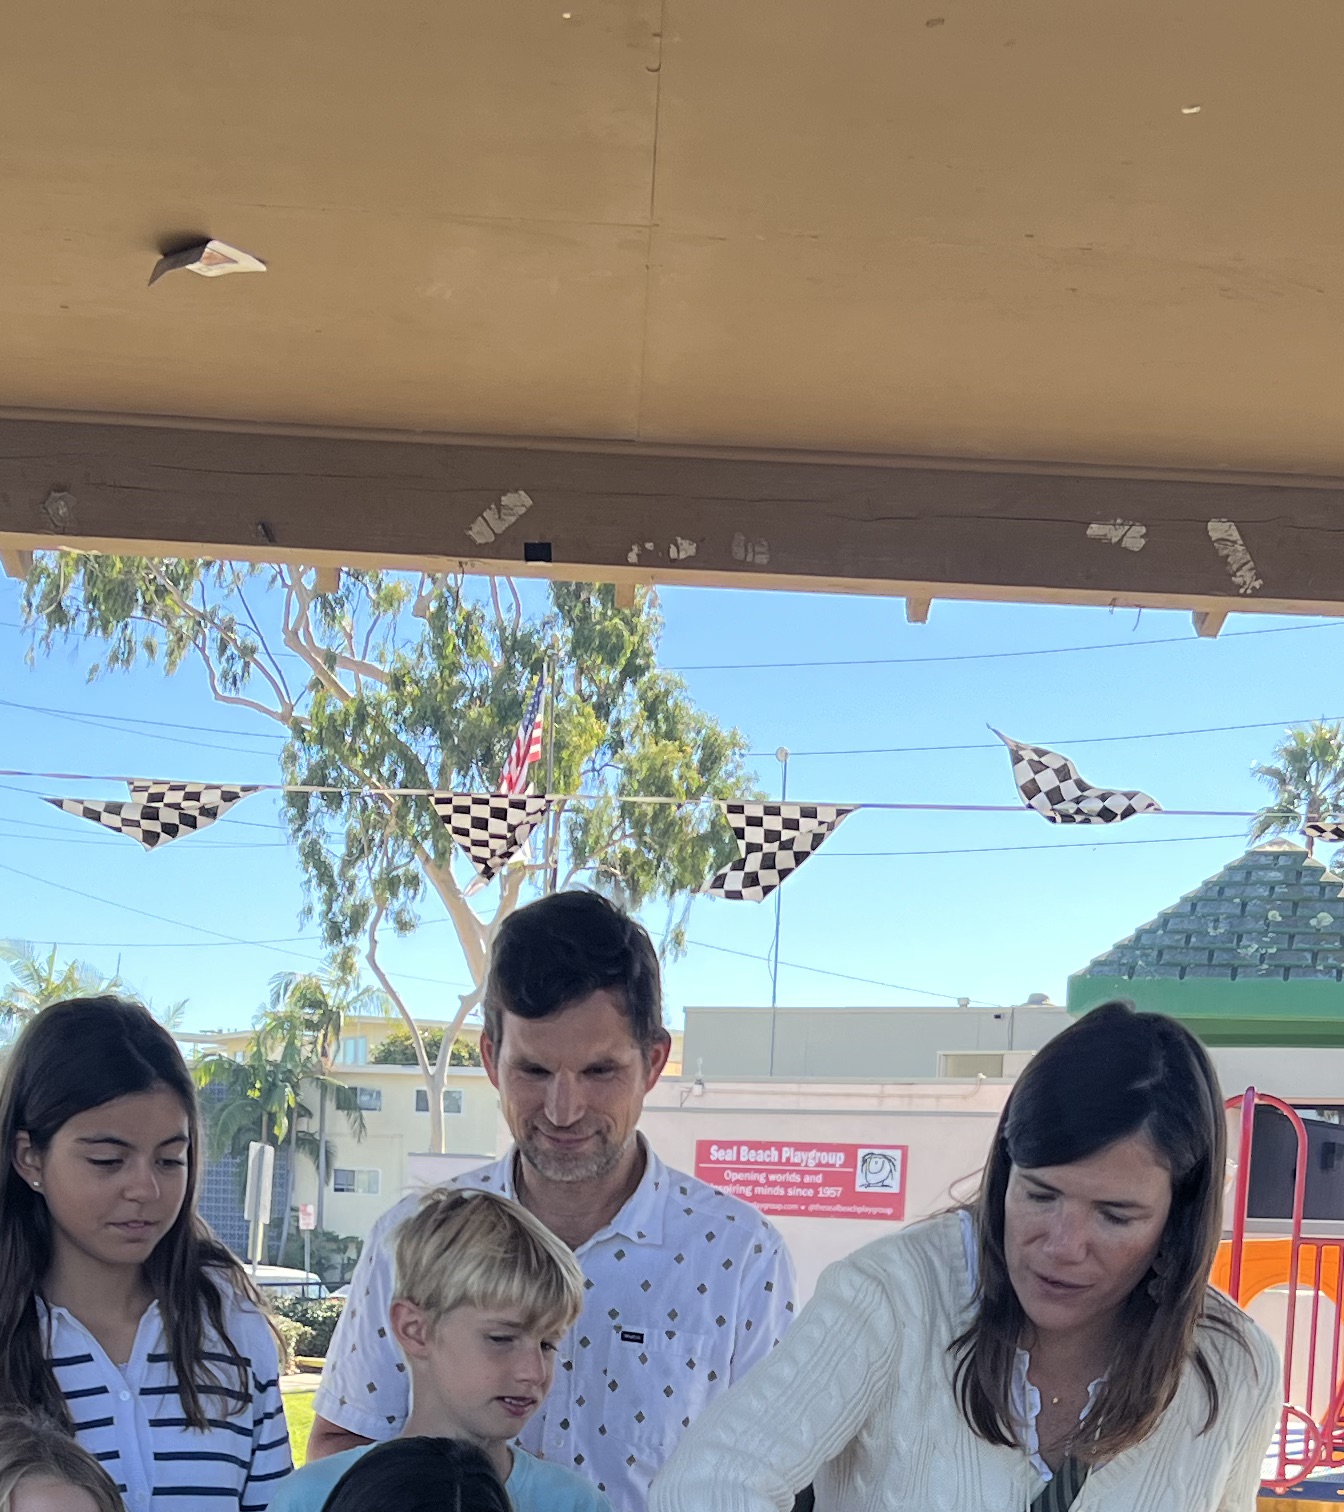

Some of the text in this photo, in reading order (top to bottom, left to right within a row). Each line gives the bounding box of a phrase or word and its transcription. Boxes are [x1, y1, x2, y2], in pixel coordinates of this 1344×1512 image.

[709, 1145, 845, 1167] Seal Beach Playgroup
[724, 1170, 823, 1184] Opening worlds and
[754, 1185, 785, 1196] minds
[787, 1186, 814, 1197] since
[817, 1187, 843, 1198] 1957
